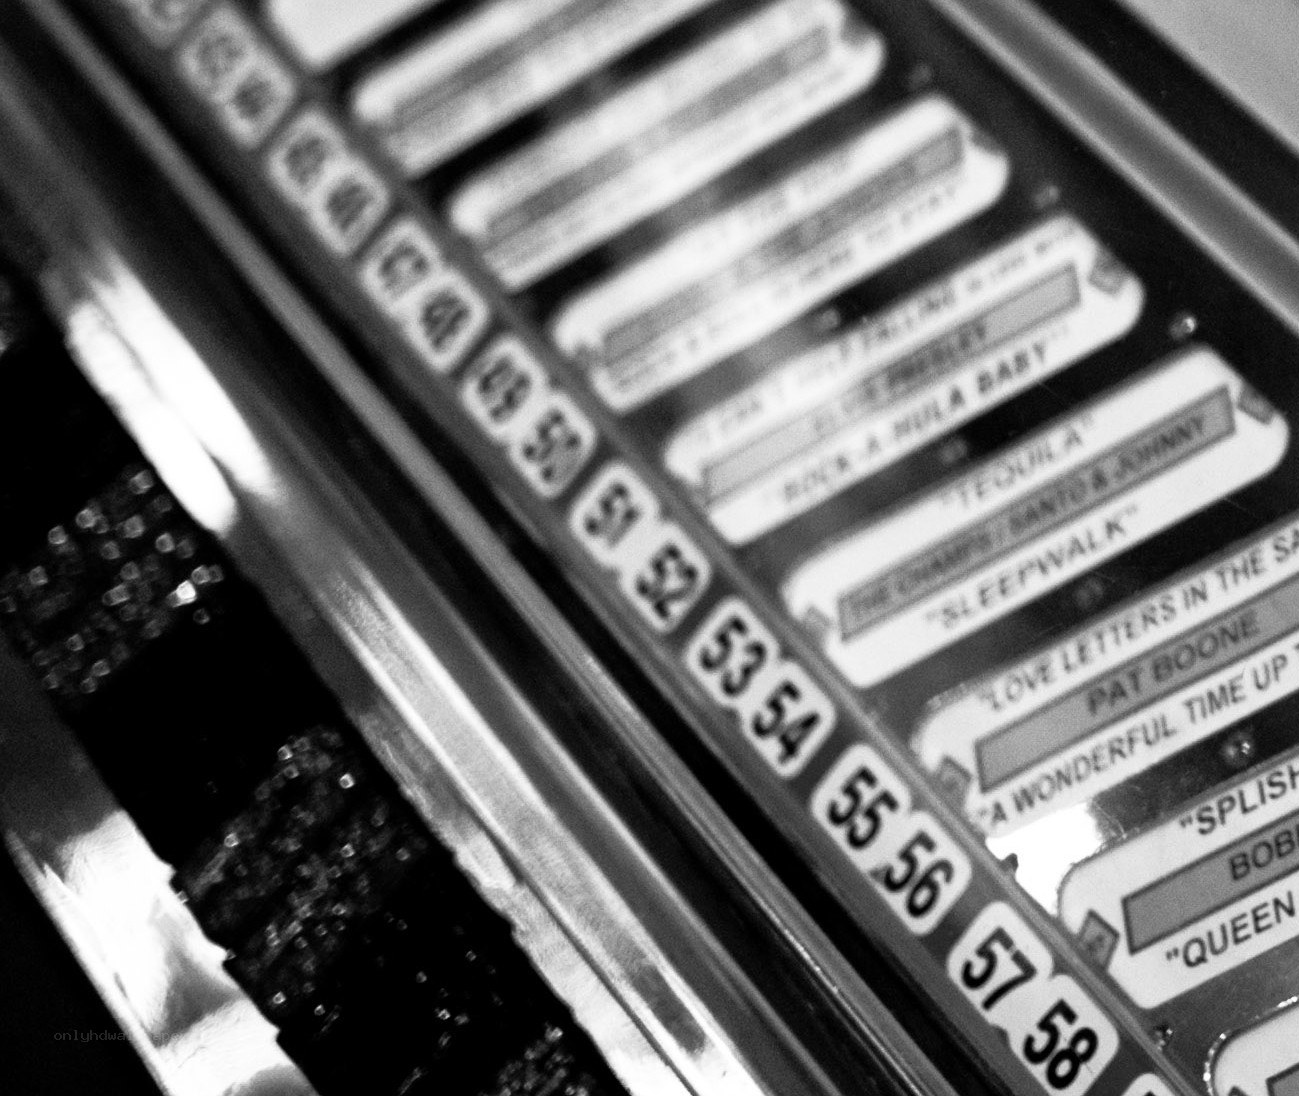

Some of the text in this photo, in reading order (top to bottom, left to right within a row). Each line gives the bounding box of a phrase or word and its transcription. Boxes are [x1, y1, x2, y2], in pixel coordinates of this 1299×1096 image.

[940, 414, 1095, 509] "TEQUILA"
[1112, 413, 1207, 481] JOHNNY
[584, 481, 640, 548] 51
[635, 541, 701, 621] 52
[927, 504, 1139, 630] "SLEEPWALK"
[1060, 592, 1179, 676] LETTERS
[1182, 580, 1210, 612] IN
[1215, 542, 1271, 593] THE
[699, 615, 767, 699] 53
[1085, 612, 1258, 718] PAT BOONE
[751, 679, 821, 765] 54
[1011, 713, 1178, 816] WONDERFUL
[1183, 670, 1248, 725] TIME
[1251, 653, 1290, 691] UP
[827, 765, 900, 850] 55
[882, 830, 955, 919] 56
[961, 926, 1038, 1012] 57
[1165, 890, 1297, 969] "QUEEN
[1023, 999, 1099, 1090] 58
